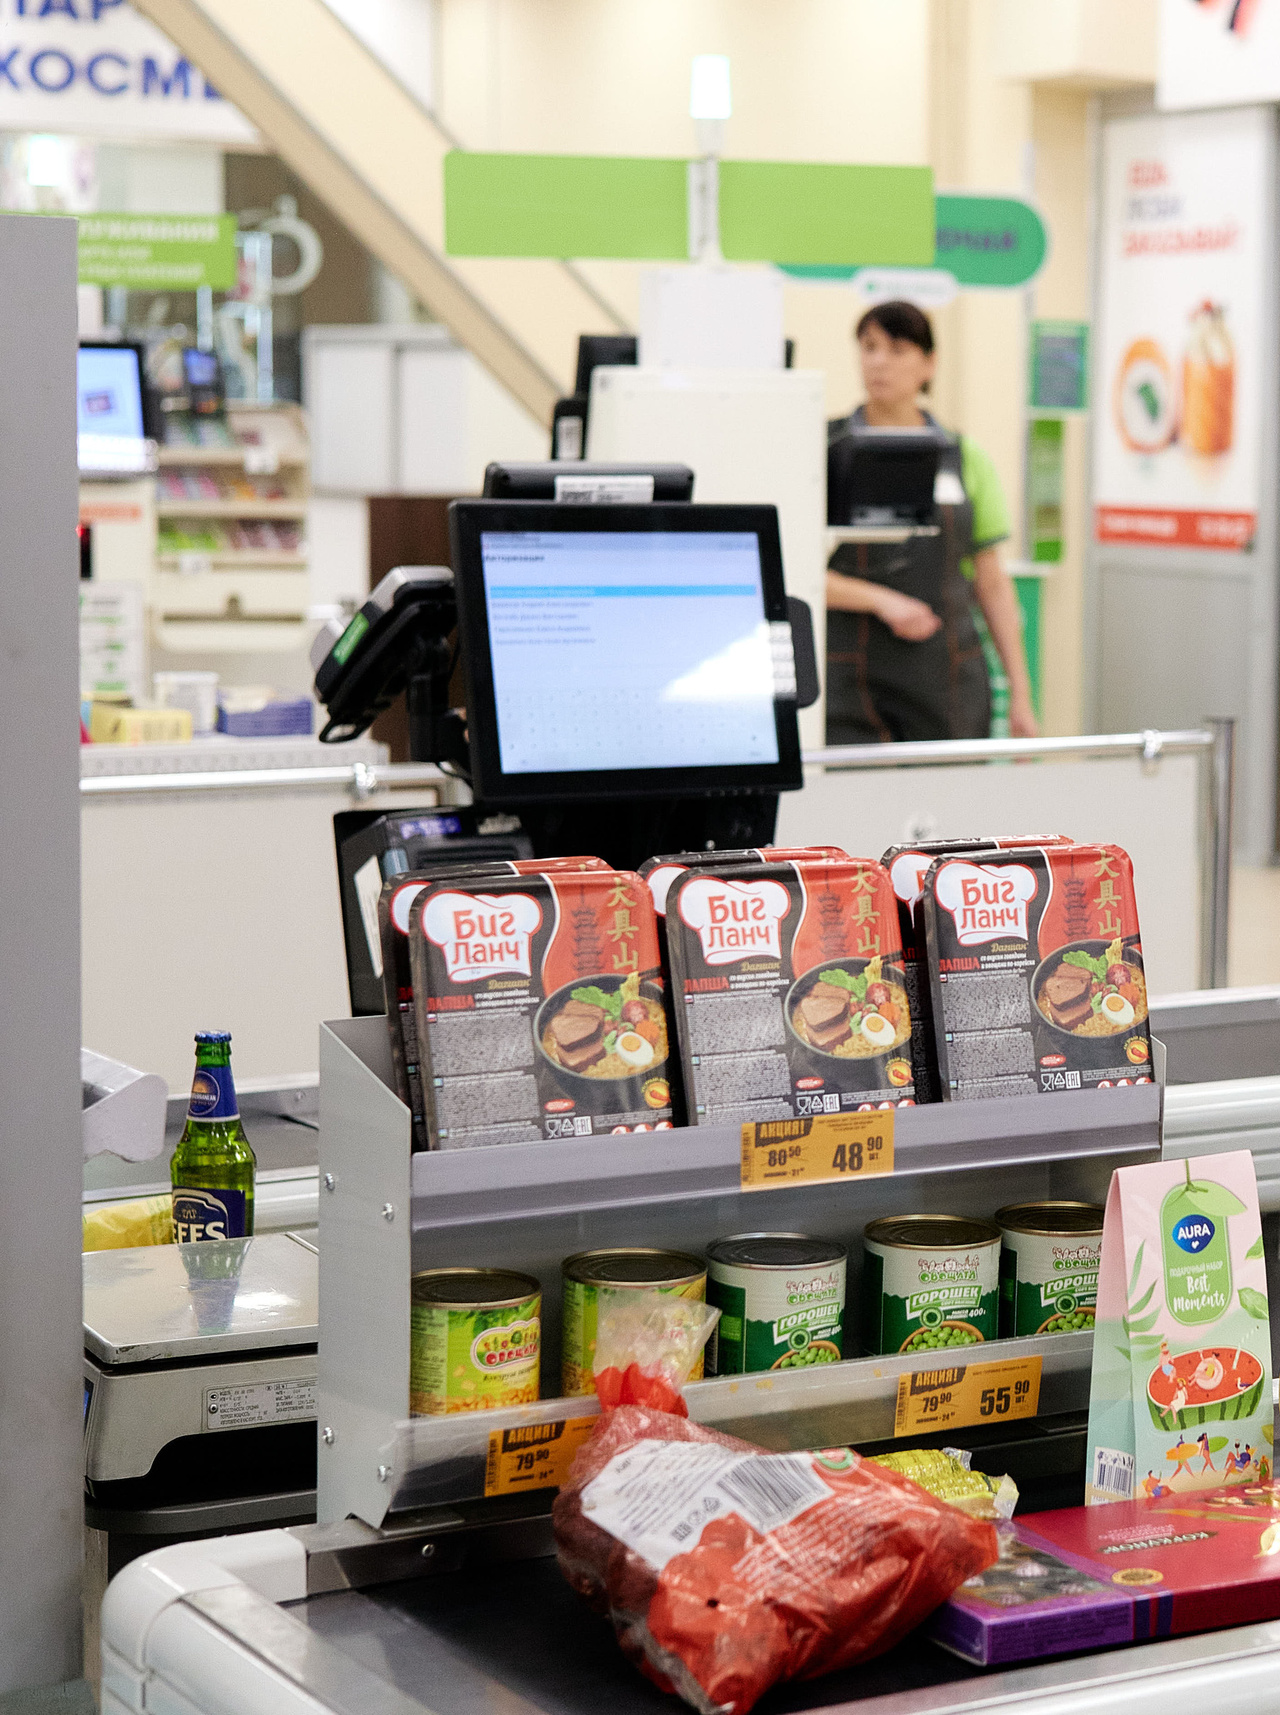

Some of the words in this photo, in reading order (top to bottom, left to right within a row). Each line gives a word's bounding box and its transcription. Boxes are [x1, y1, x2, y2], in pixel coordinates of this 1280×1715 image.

[0, 49, 222, 98] КОСМ
[961, 878, 1015, 906] Биг
[708, 895, 766, 924] Биг
[961, 907, 1018, 930] Ланч
[453, 909, 516, 940] Биг
[708, 925, 770, 948] Ланч
[452, 941, 520, 965] Ланч
[939, 957, 980, 972] ЛАПША
[760, 1119, 805, 1139] АКЦИЯ!
[768, 1150, 786, 1167] 80
[832, 1142, 863, 1172] 48
[867, 1136, 883, 1150] 90
[1178, 1223, 1211, 1240] AURA
[1047, 1274, 1099, 1294] ГОРОШ
[1186, 1273, 1210, 1294] Best
[912, 1286, 979, 1307] ГОРОШЕК
[780, 1303, 839, 1330] ГОРОШЕК
[915, 1367, 959, 1387] АКЦИЯ!
[923, 1396, 938, 1413] 79
[940, 1392, 952, 1403] 90
[980, 1387, 1011, 1415] 55
[1015, 1380, 1030, 1394] 90
[516, 1453, 533, 1471] 79
